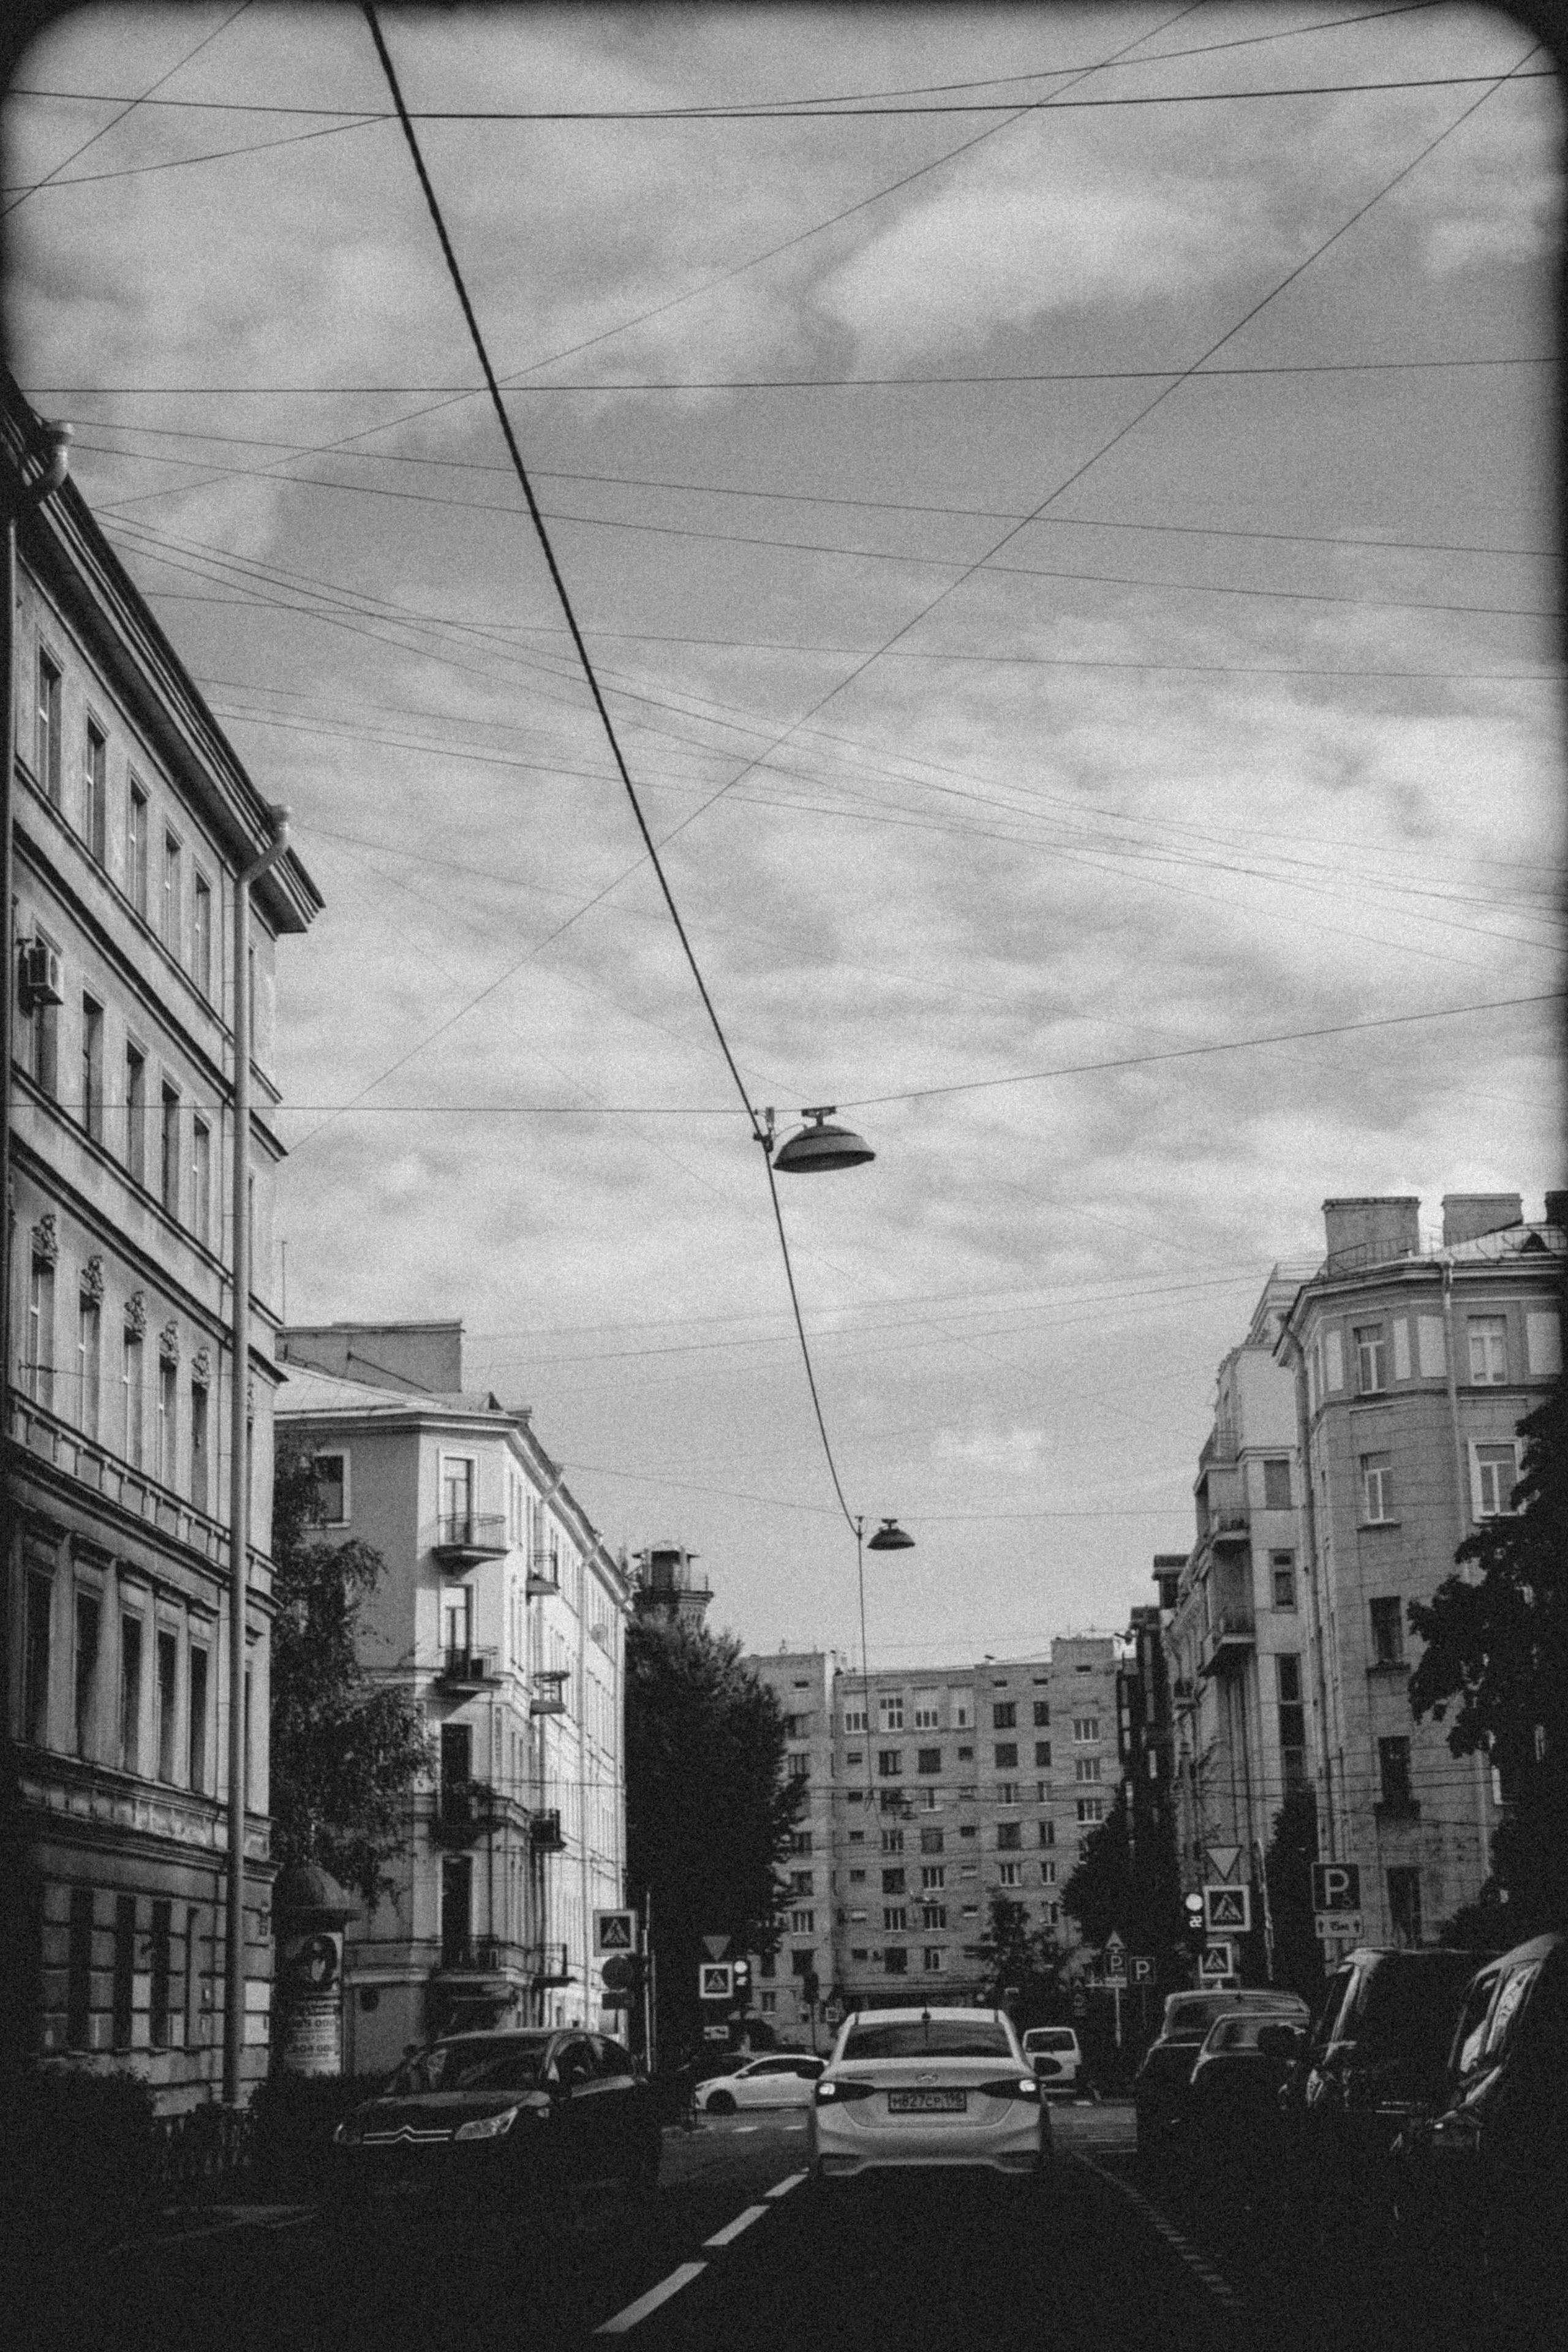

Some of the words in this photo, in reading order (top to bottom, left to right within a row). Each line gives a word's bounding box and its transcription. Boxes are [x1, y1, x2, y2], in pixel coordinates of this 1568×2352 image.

[1325, 1869, 1350, 1905] P
[1110, 1955, 1123, 1973] P
[1136, 1961, 1150, 1980] P
